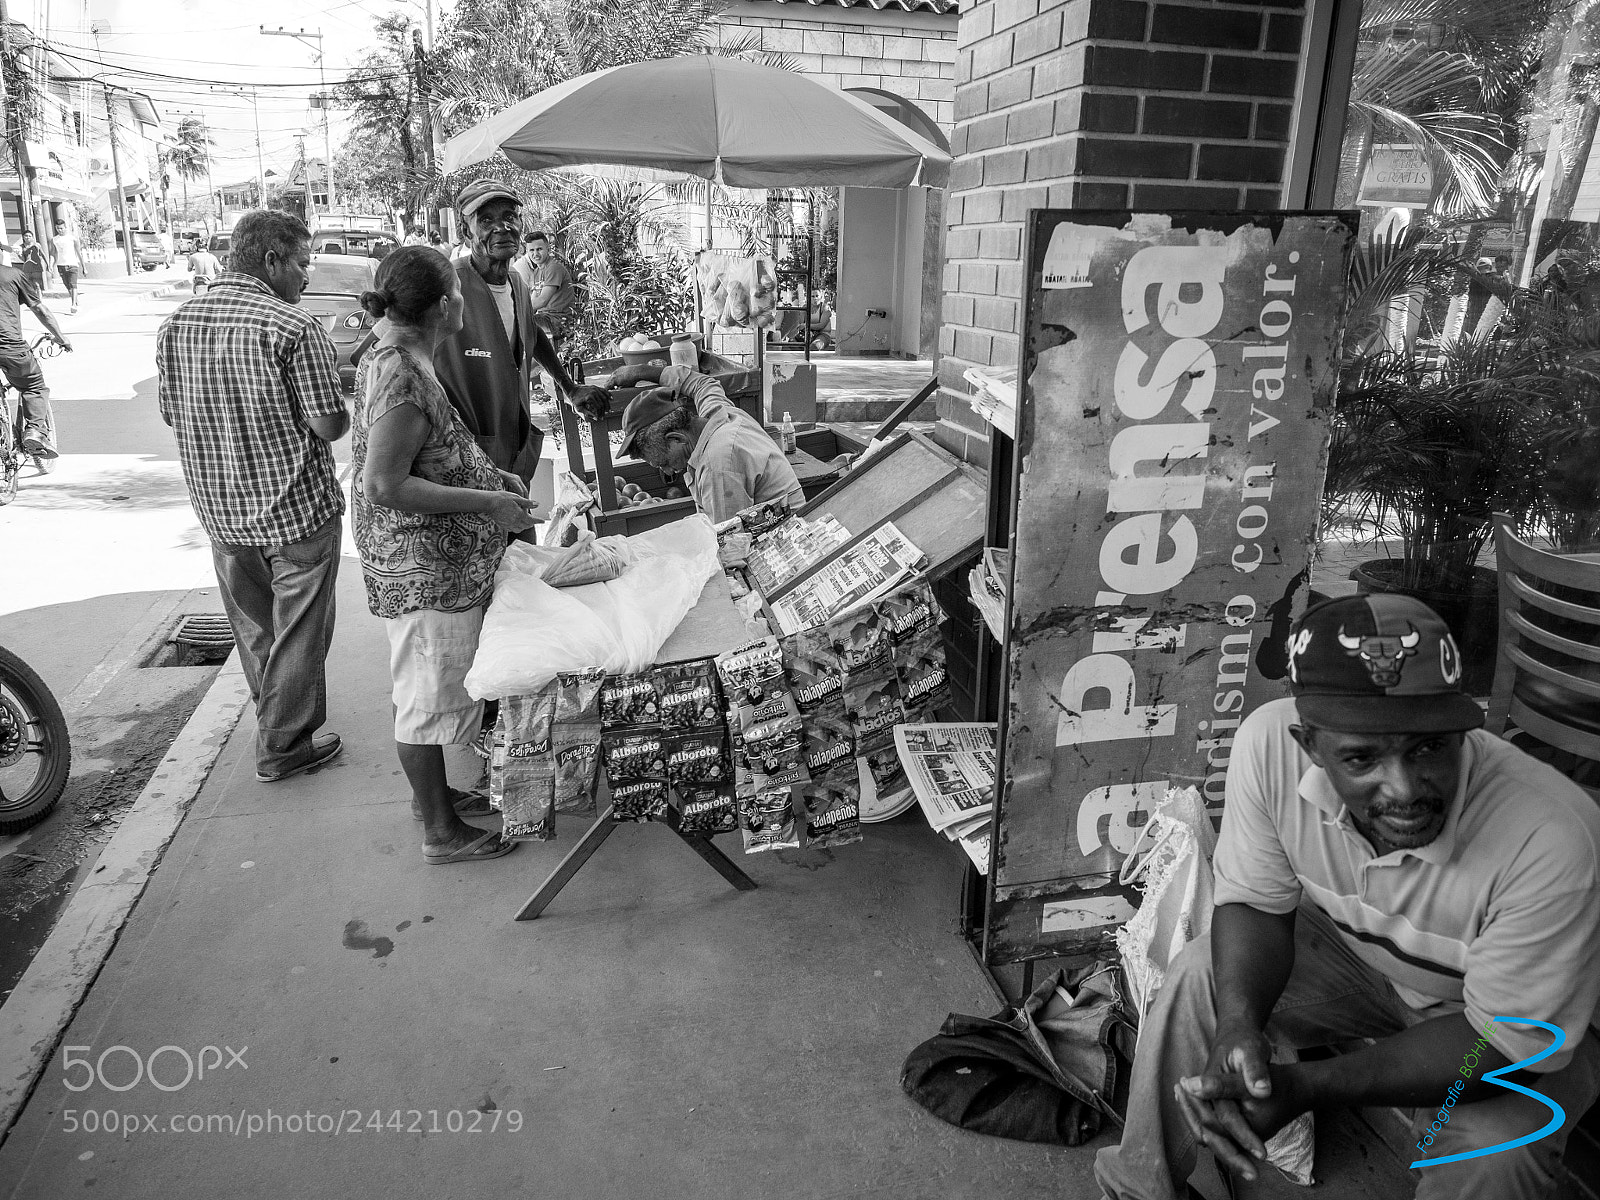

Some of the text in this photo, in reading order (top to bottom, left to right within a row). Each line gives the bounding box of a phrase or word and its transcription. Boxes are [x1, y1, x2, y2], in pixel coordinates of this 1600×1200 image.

[1376, 170, 1428, 184] GRATIS
[464, 348, 492, 358] diez
[1242, 250, 1300, 443] valor.
[1055, 245, 1229, 747] Prensa
[1231, 461, 1277, 574] con
[867, 543, 890, 568] Prensa
[603, 681, 654, 702] Alboroto
[661, 686, 711, 708] Alboroto
[798, 674, 842, 703] Jalapeños
[853, 709, 901, 739] Nachos
[611, 741, 661, 759] Alboroto
[669, 745, 719, 765] Alboroto
[808, 741, 851, 768] Jalapeños
[683, 796, 732, 816] Alboroto
